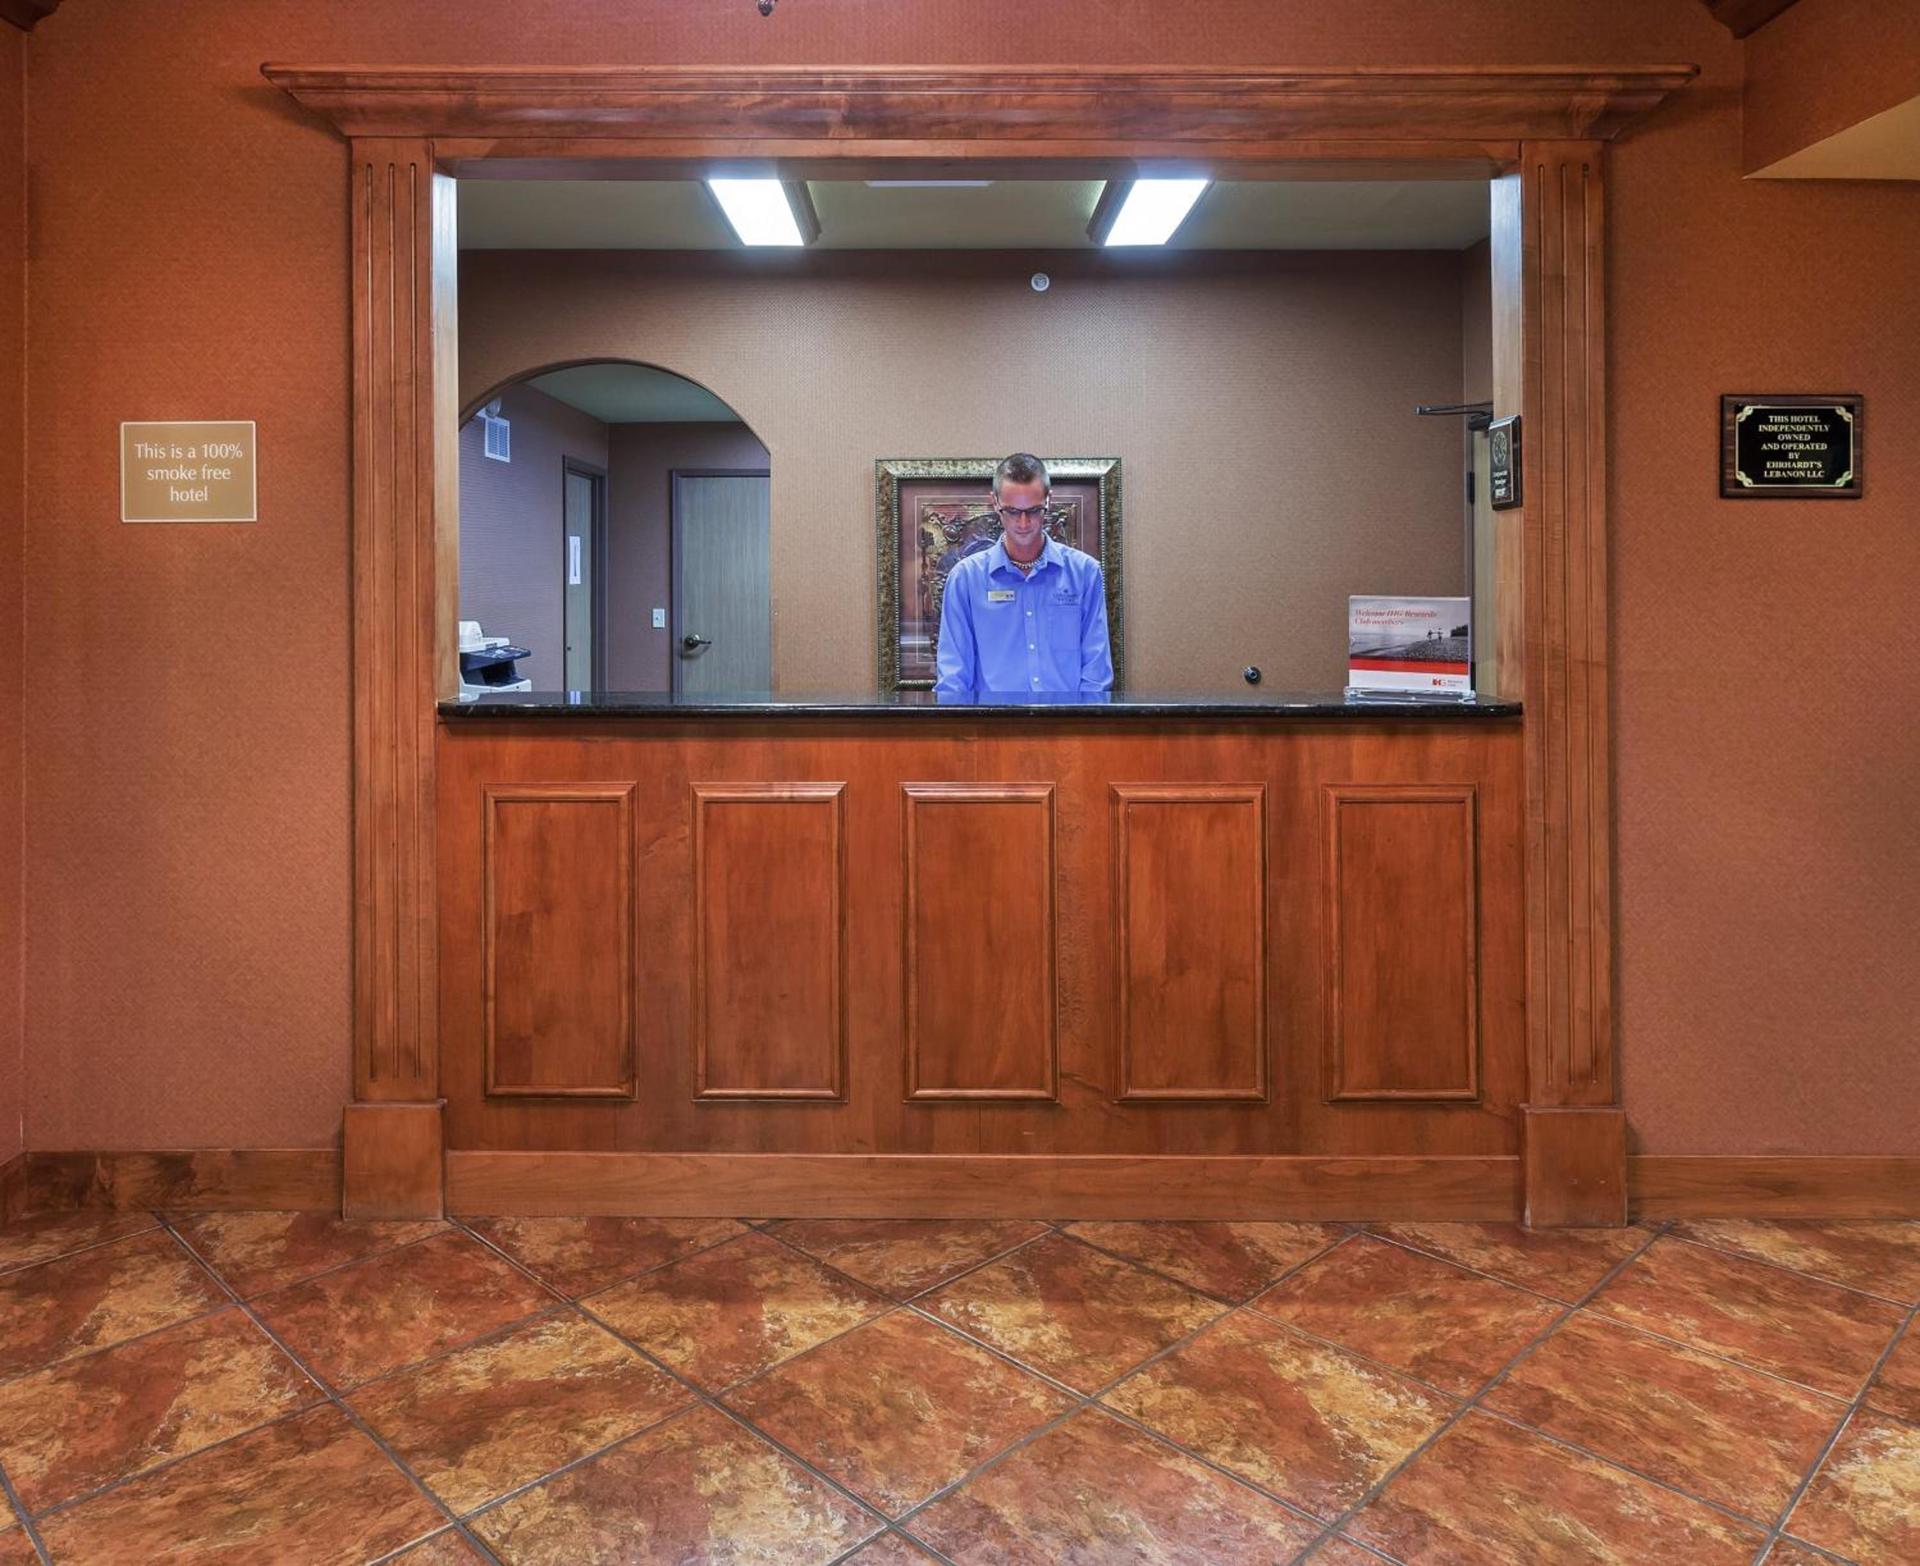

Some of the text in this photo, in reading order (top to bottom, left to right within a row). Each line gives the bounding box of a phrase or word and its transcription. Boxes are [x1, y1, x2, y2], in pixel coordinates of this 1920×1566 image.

[1768, 415, 1821, 423] THIS HOTEL
[1758, 424, 1830, 432] INDEPENDENTLY
[134, 443, 243, 459] This is a 100%
[1788, 452, 1800, 460] BY
[147, 463, 232, 480] smoke free
[1764, 470, 1825, 478] LEBANON LLC
[170, 485, 208, 502] hotel
